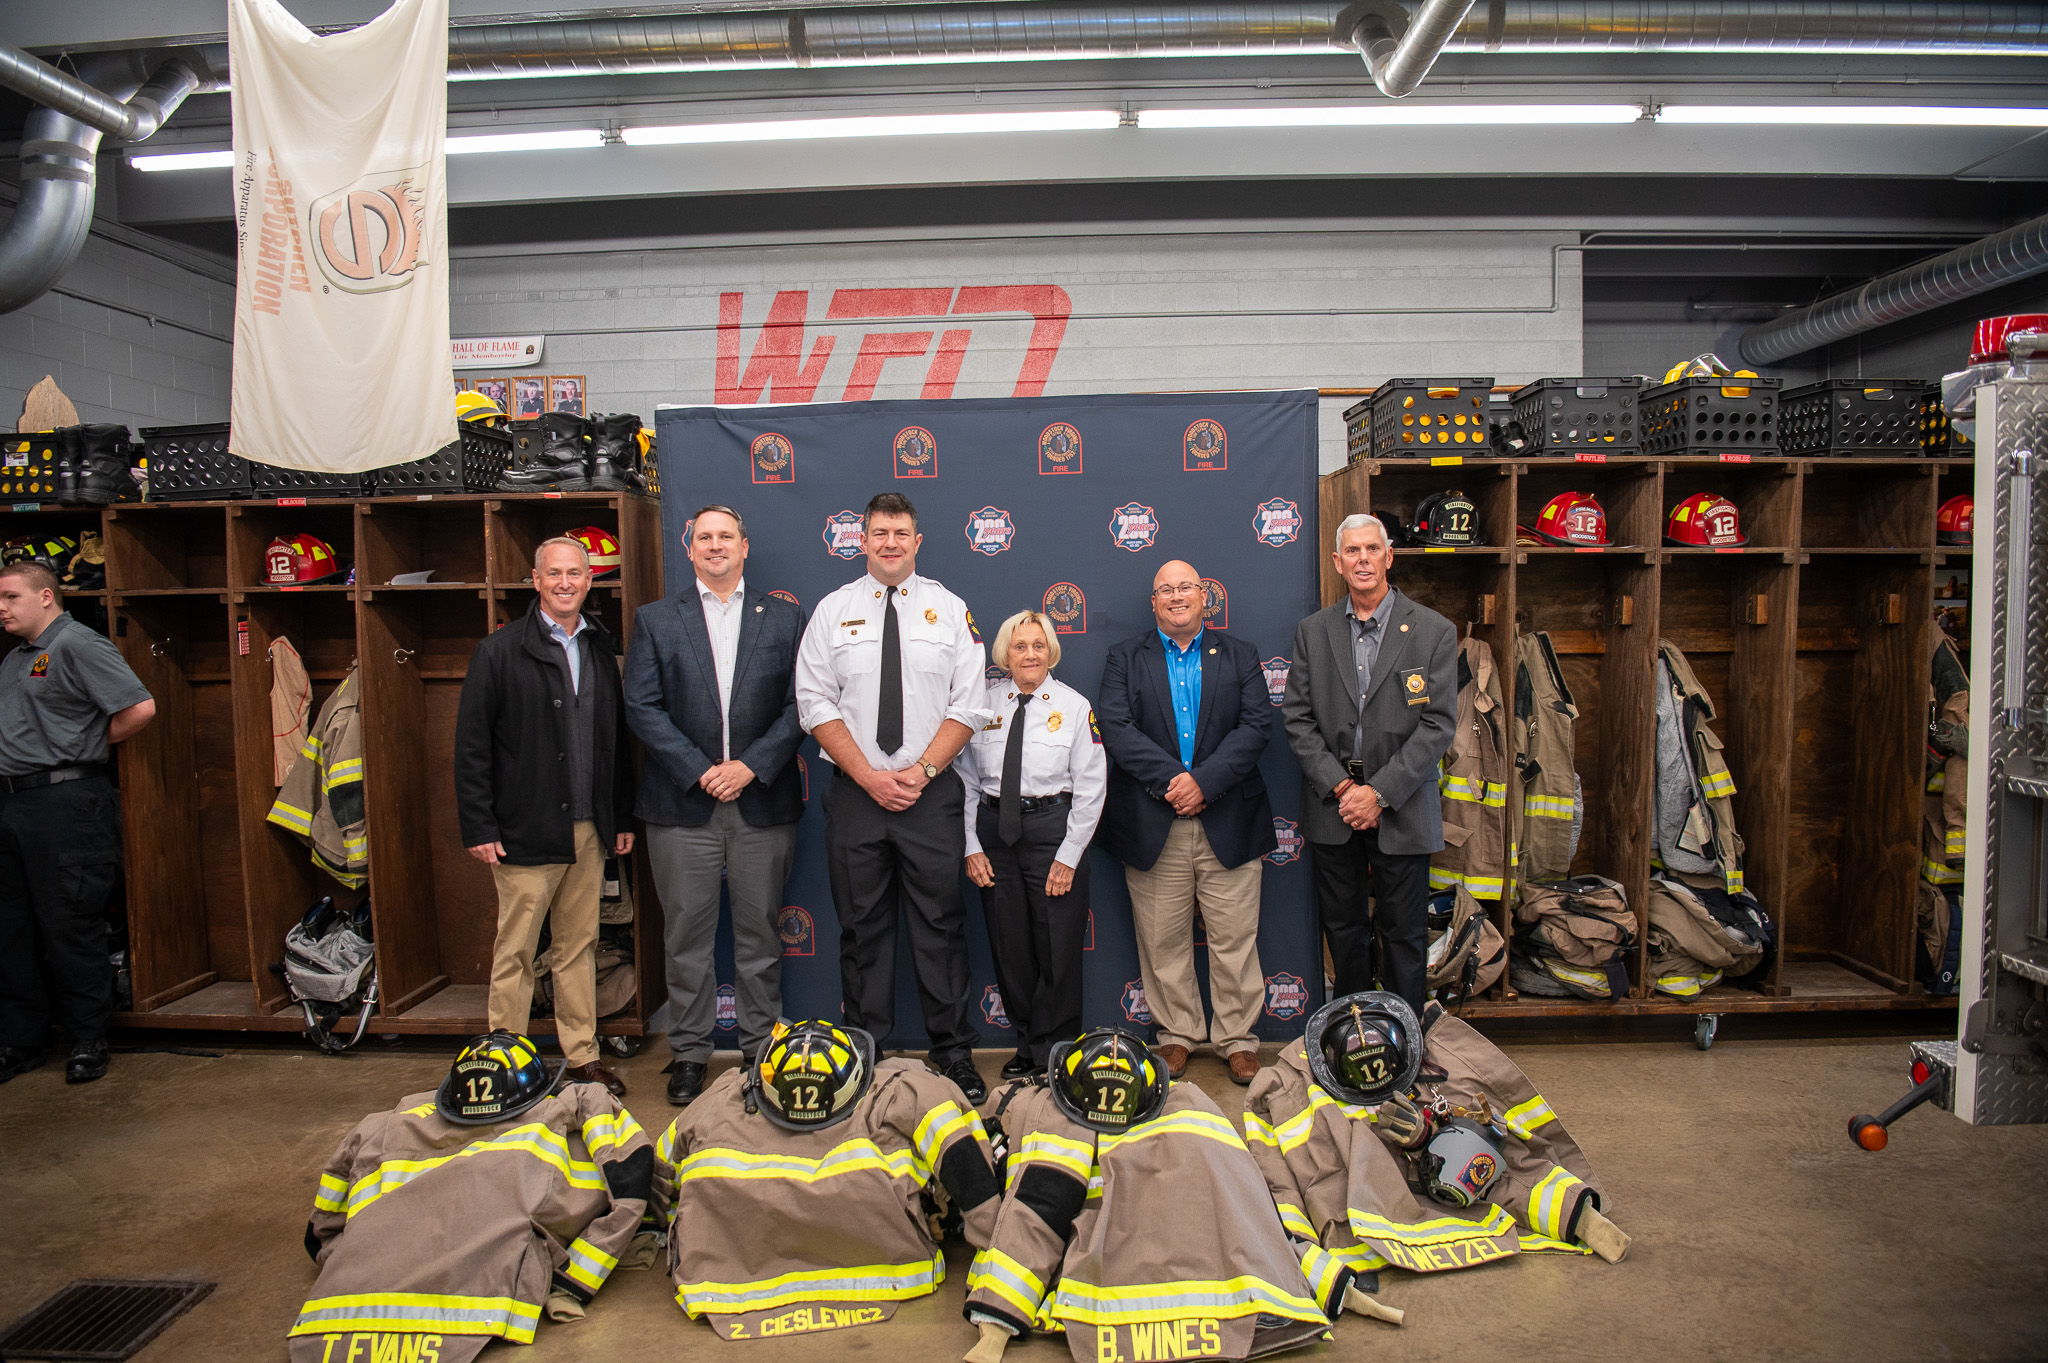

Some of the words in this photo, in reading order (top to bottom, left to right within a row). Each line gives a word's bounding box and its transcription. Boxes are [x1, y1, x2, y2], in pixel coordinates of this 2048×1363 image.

[246, 150, 257, 172] Fire
[240, 174, 254, 228] Apparatus
[452, 342, 474, 352] HALL
[478, 342, 489, 352] OF
[492, 342, 520, 352] FLAME
[714, 284, 1072, 405] WFD
[1448, 502, 1473, 510] FIREFIGHTER
[1707, 506, 1736, 516] FIREFIGHTER
[974, 519, 1005, 543] 200
[1118, 515, 1149, 539] 200
[1262, 510, 1292, 535] 200
[1450, 514, 1470, 531] 12
[1574, 516, 1596, 534] 12
[1714, 516, 1735, 536] 12
[832, 523, 862, 547] 200
[267, 546, 294, 556] FIREFIGHTER
[270, 556, 290, 574] 12
[1269, 984, 1299, 1007] 200
[460, 1062, 496, 1070] FIREFIGHTER
[1095, 1071, 1131, 1082] FIREFIGHTER
[1361, 1058, 1388, 1082] 12
[466, 1076, 494, 1102] 12
[792, 1086, 819, 1110] 12
[1098, 1086, 1126, 1112] 12
[464, 1105, 500, 1114] WOODSTOCK
[1090, 1112, 1126, 1122] WOODSTOCK
[730, 1323, 750, 1338] Z.
[760, 1306, 884, 1336] CIESLEWICZ
[346, 1332, 443, 1363] EVANS
[1098, 1325, 1124, 1363] B.
[1130, 1318, 1222, 1361] WINES
